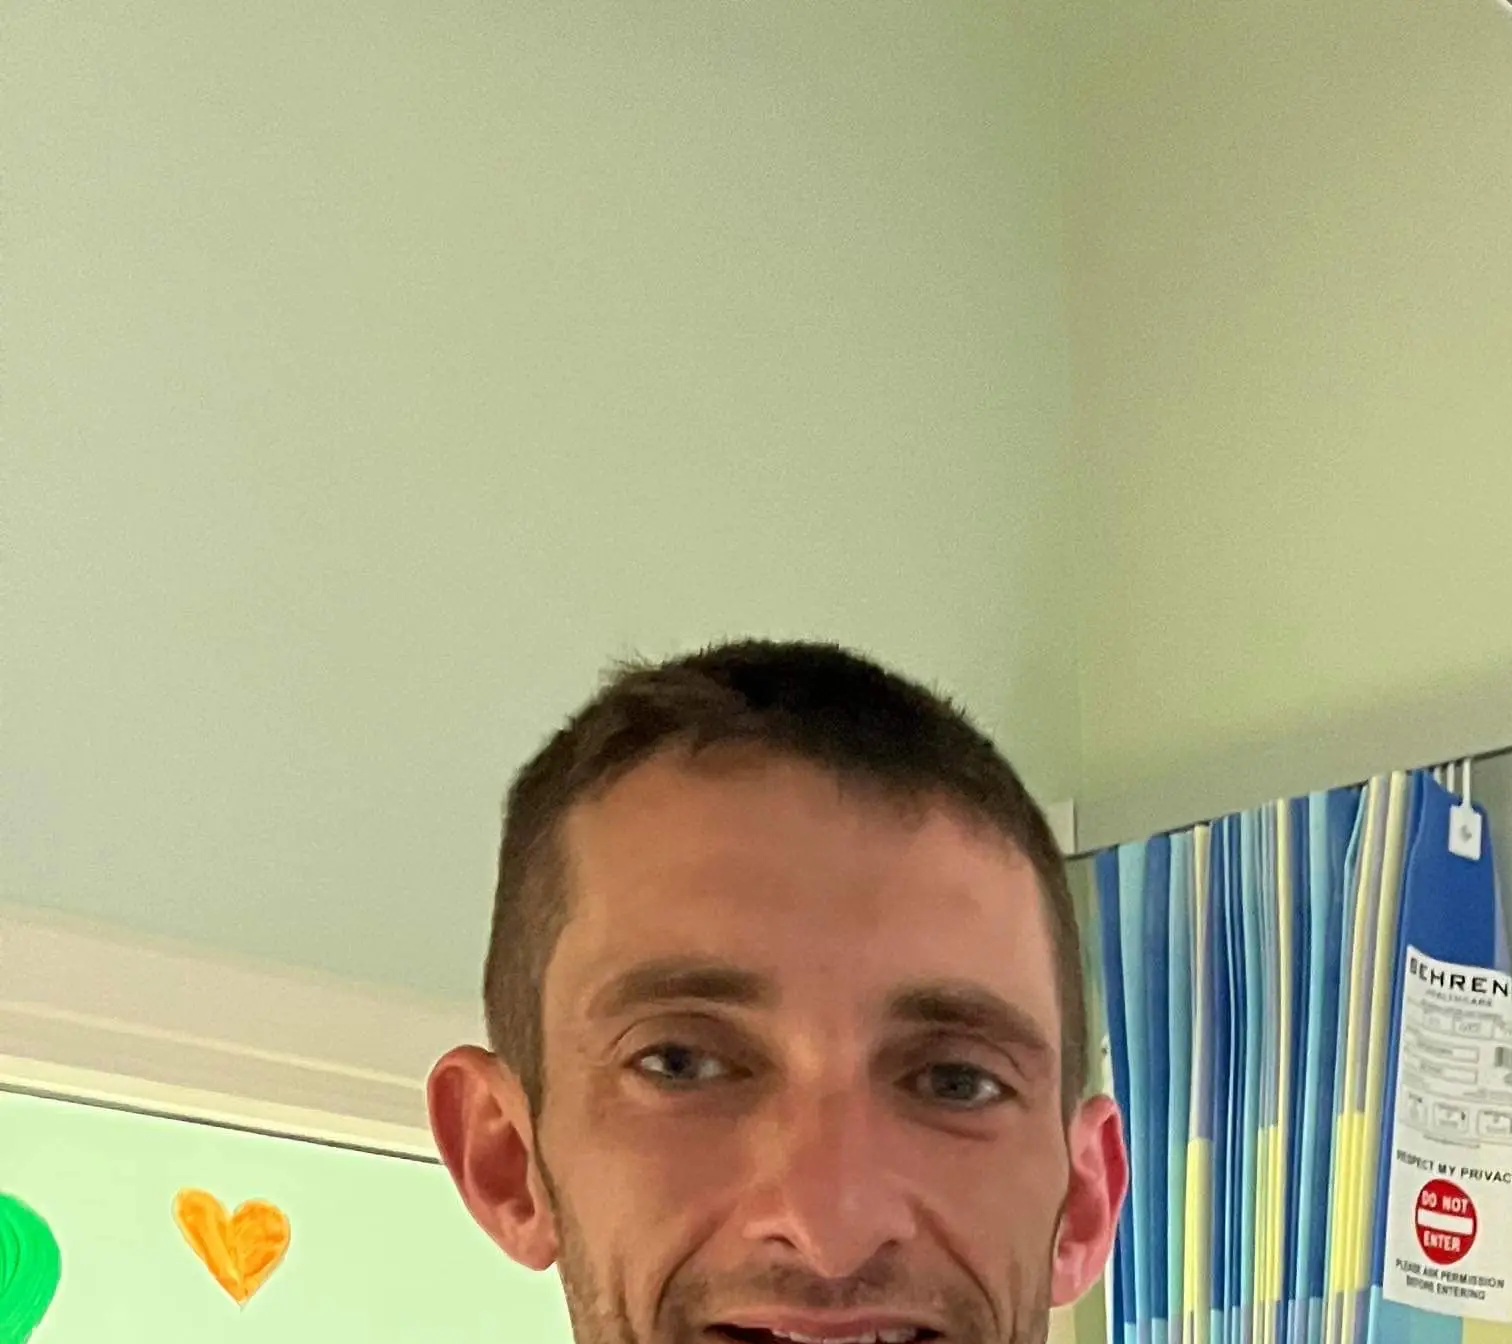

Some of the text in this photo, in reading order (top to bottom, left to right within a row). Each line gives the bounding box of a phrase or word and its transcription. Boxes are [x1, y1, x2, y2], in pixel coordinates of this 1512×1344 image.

[1409, 957, 1509, 998] BEHREN
[1396, 1149, 1434, 1171] RESPECT
[1437, 1163, 1458, 1176] MY
[1421, 1190, 1470, 1214] DO NOT
[1423, 1230, 1461, 1253] ENTER
[1441, 1270, 1505, 1289] PERMISSION
[1437, 1283, 1486, 1301] ENTERING
